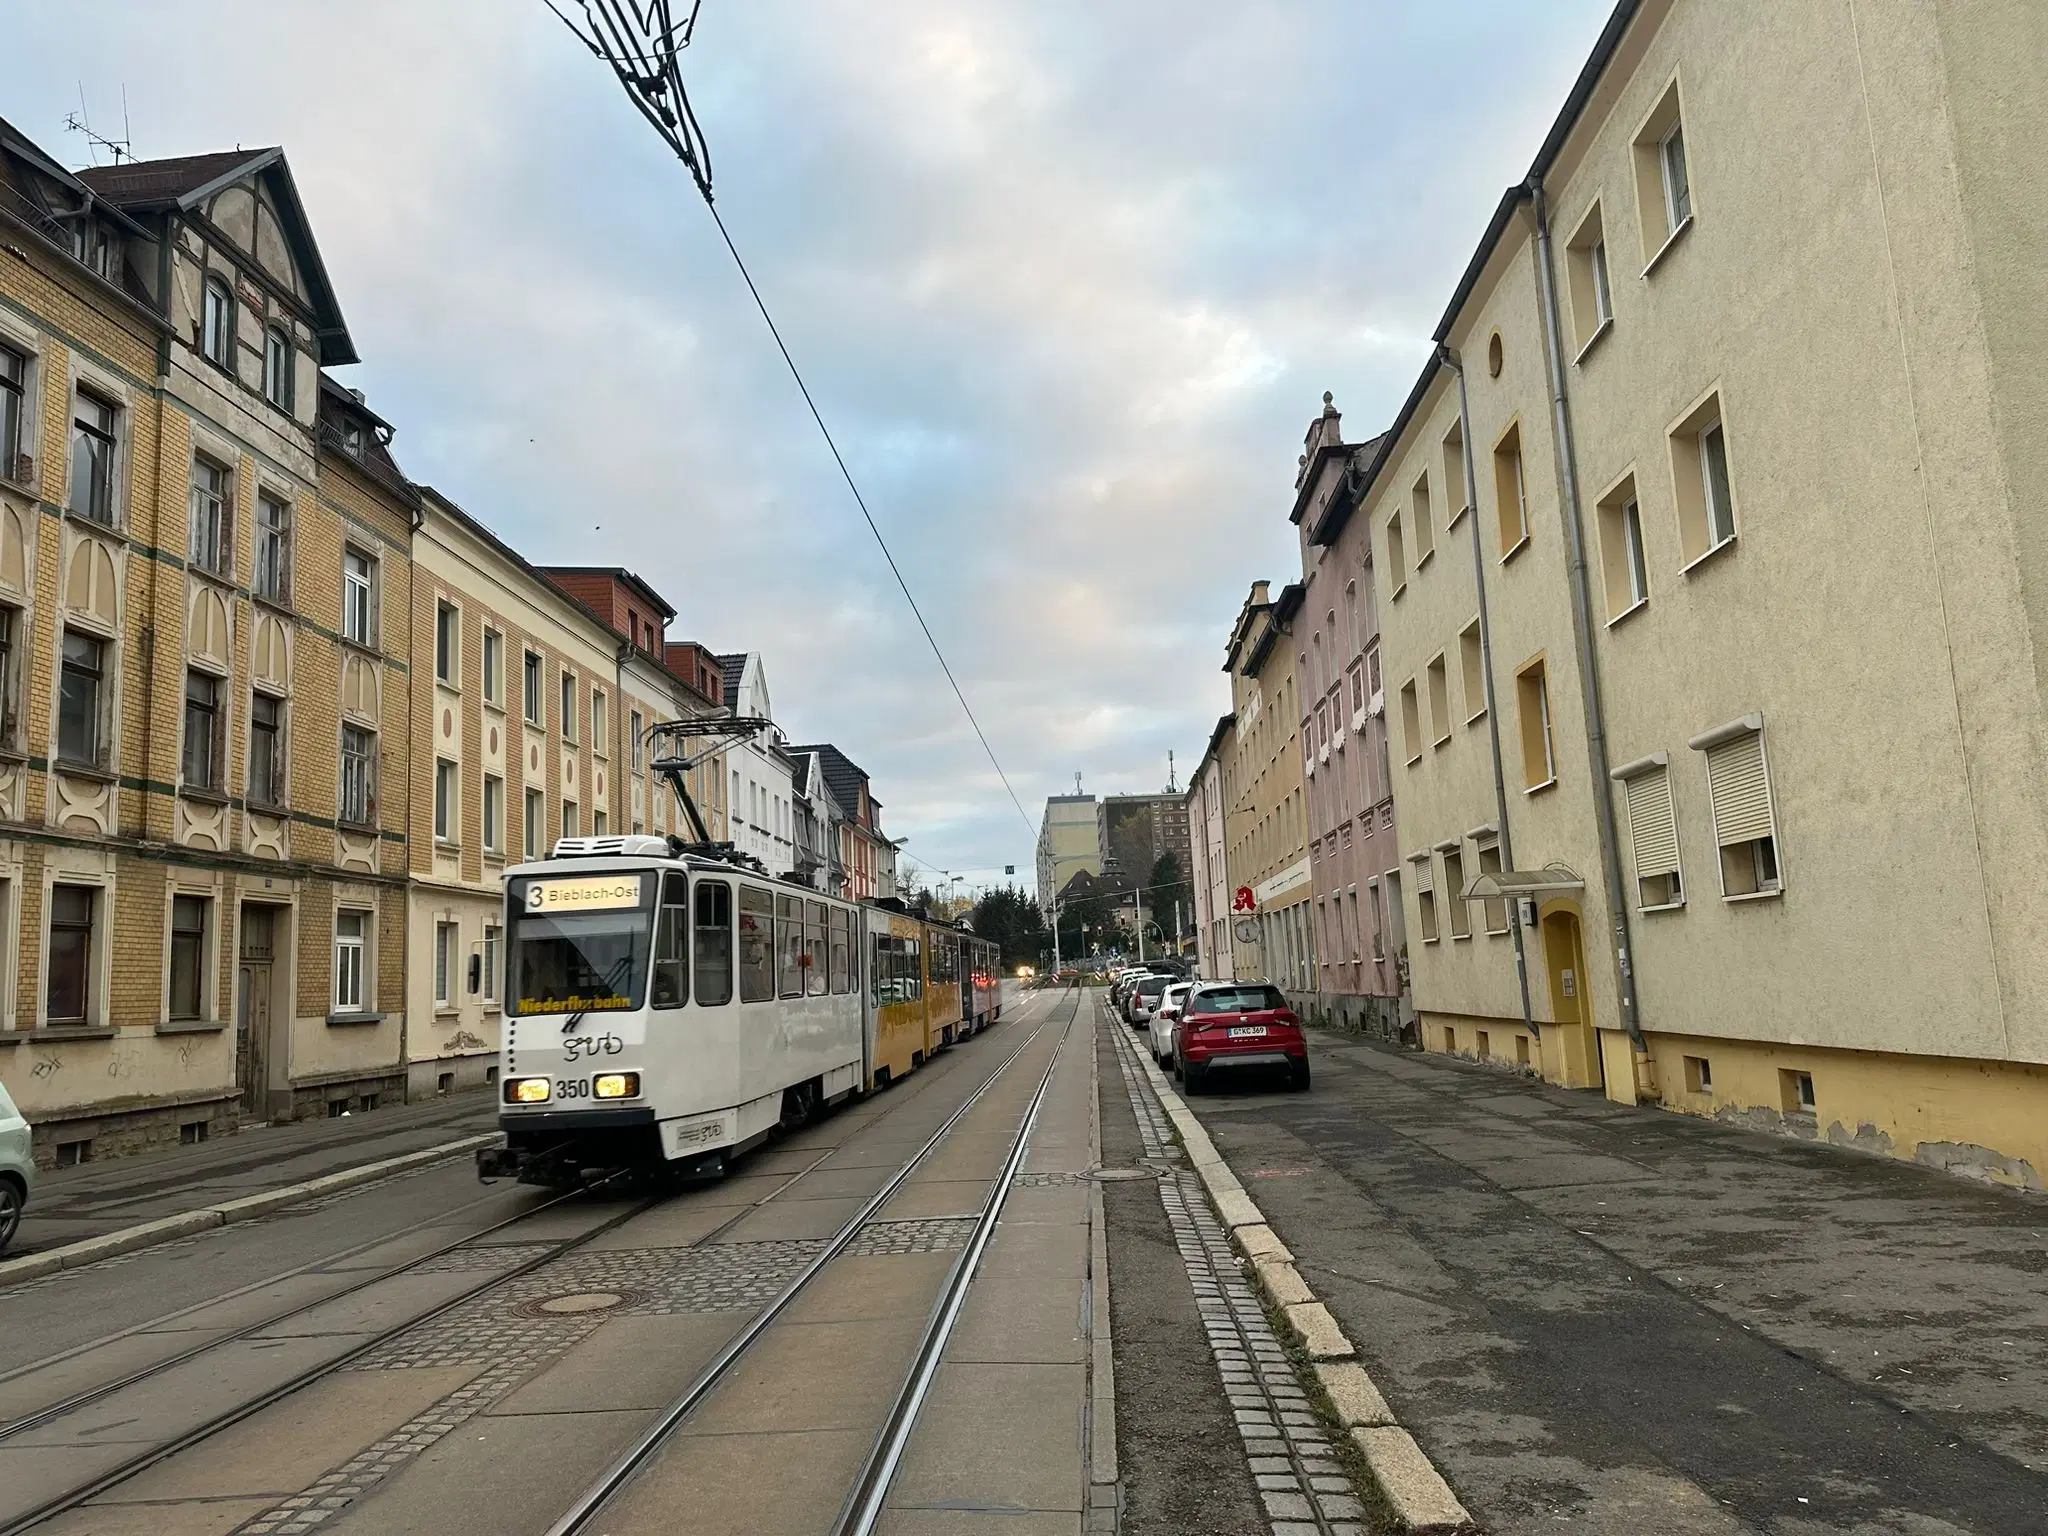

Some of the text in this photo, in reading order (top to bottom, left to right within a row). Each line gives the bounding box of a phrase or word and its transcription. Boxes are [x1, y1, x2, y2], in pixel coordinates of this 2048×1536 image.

[1005, 866, 1014, 874] W
[529, 886, 639, 908] 3 Bieblach-Ost
[556, 1079, 589, 1099] 350
